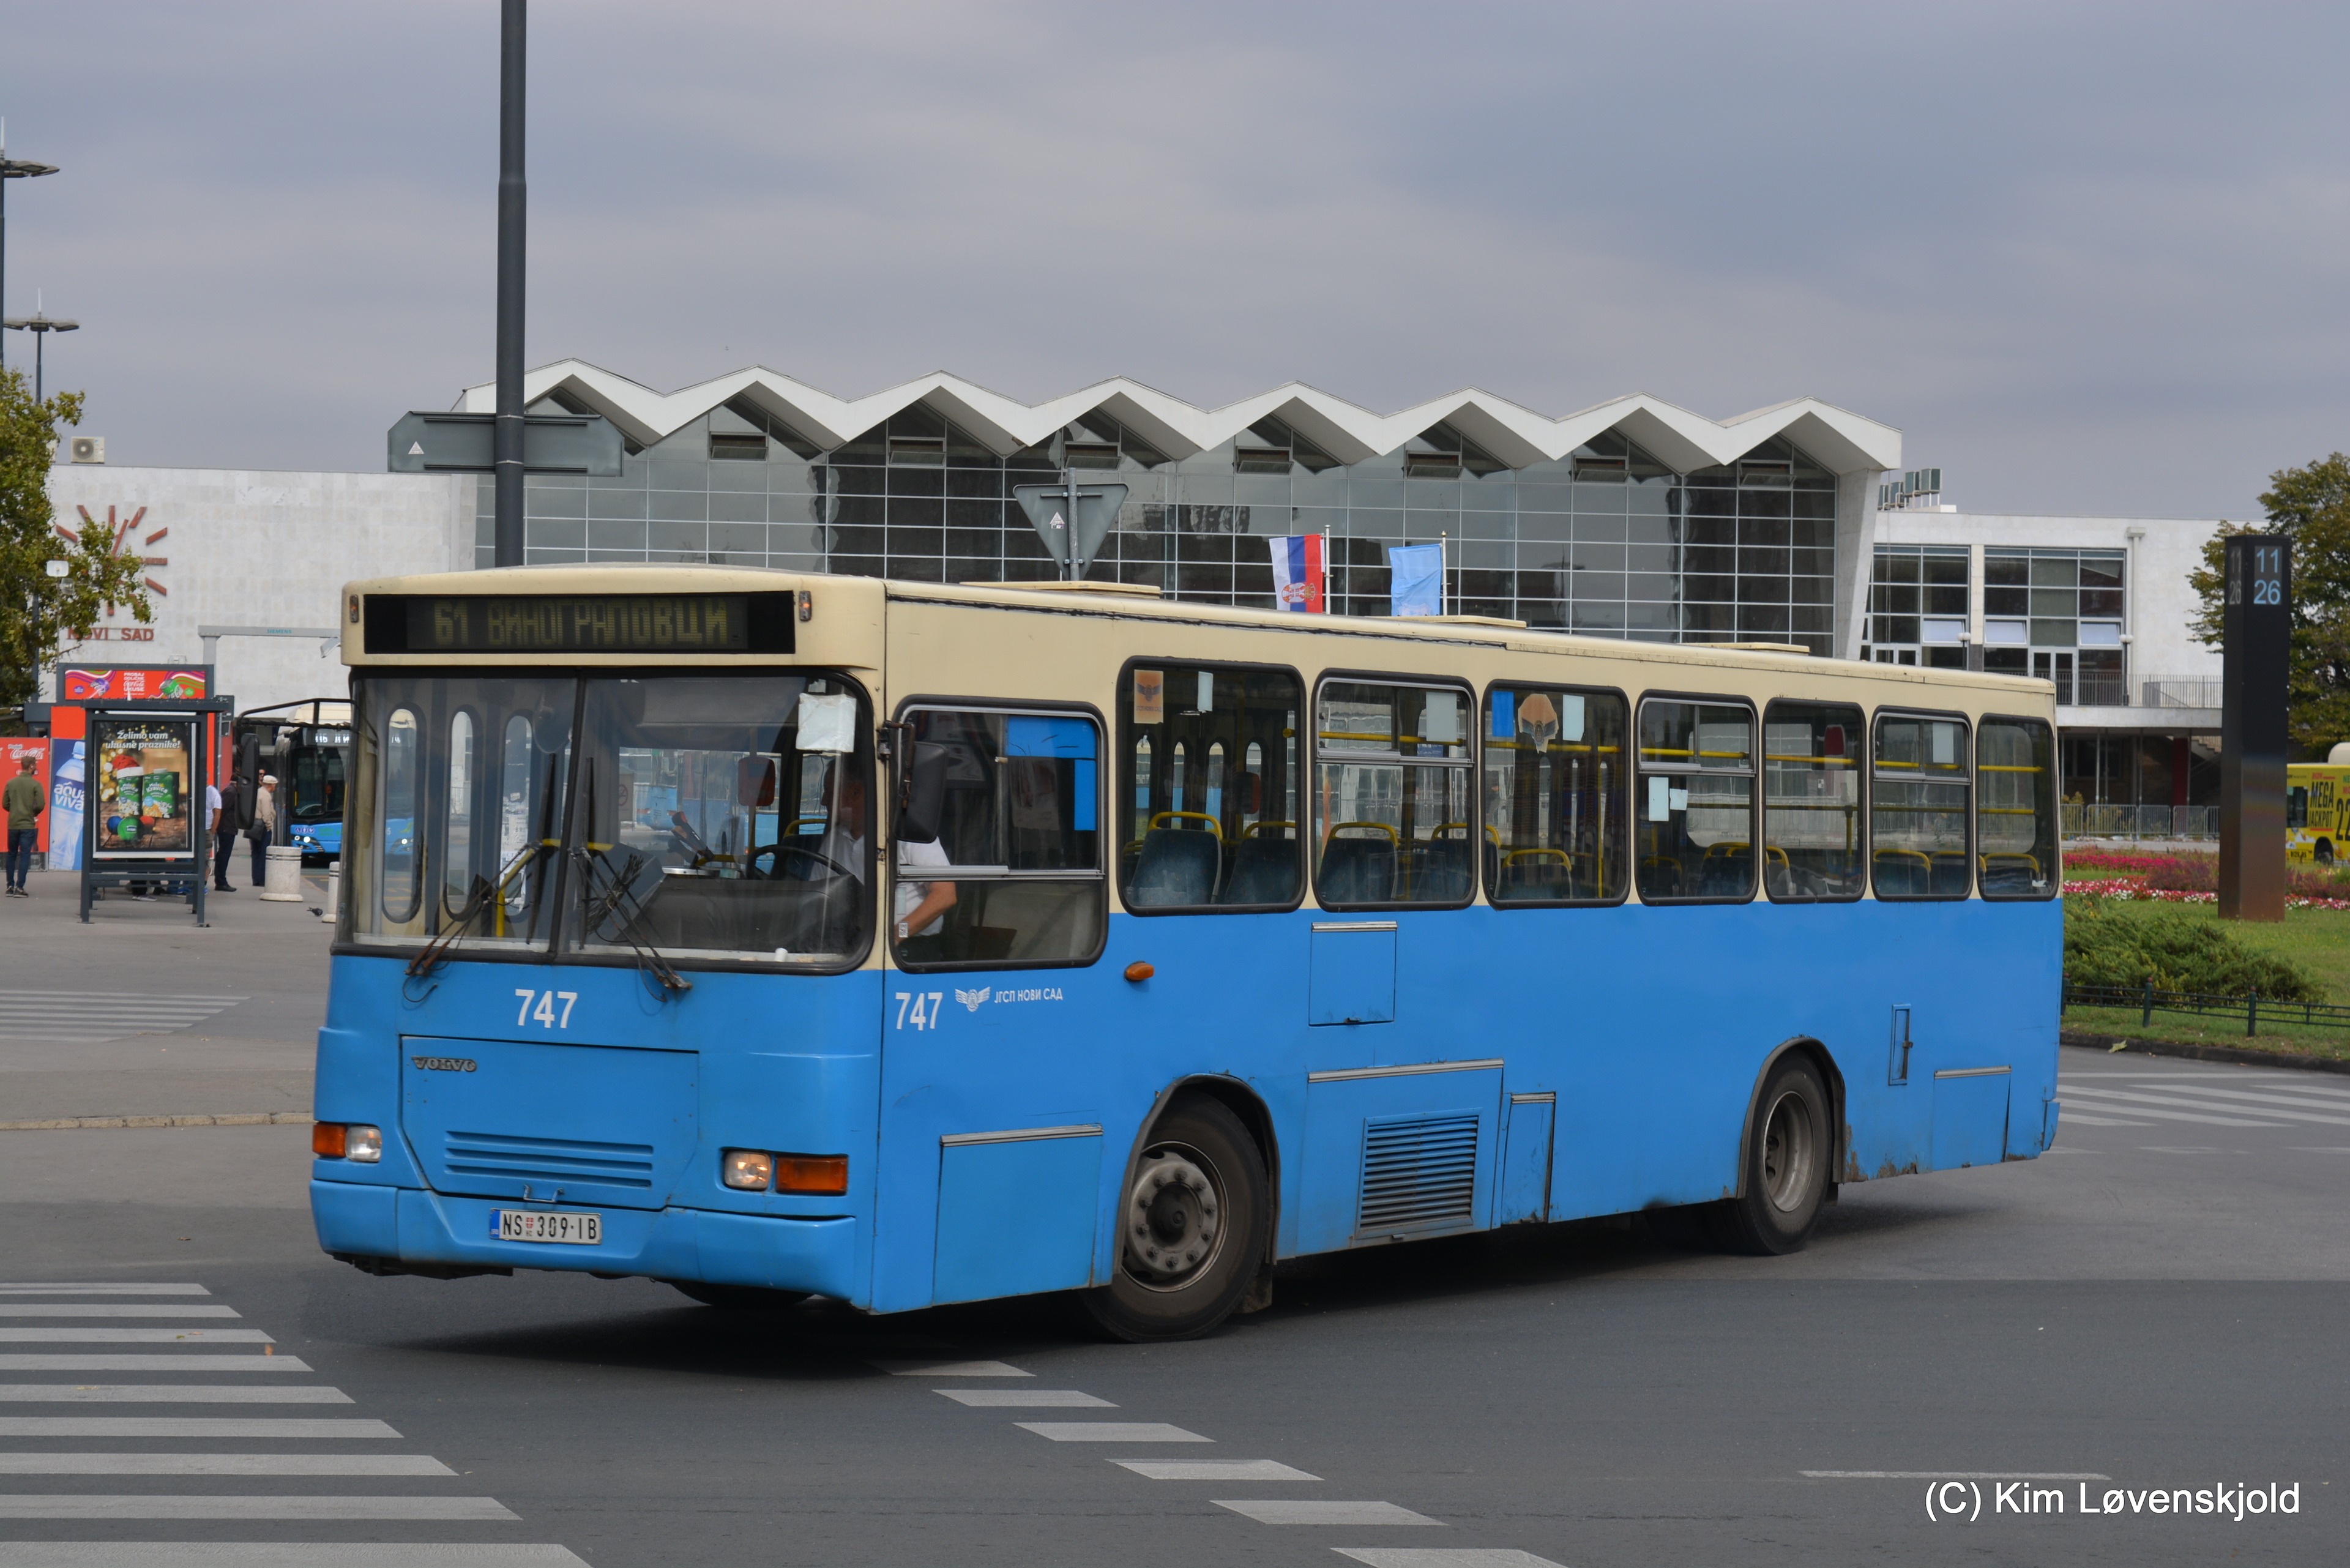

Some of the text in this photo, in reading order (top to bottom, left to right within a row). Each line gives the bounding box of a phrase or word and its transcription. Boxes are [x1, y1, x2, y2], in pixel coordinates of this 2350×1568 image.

[2256, 548, 2278, 573] 11
[2229, 580, 2241, 605] 26
[2253, 579, 2281, 605] 26
[435, 601, 469, 644] 61
[121, 627, 154, 641] SAD
[117, 730, 147, 739] Želimo
[138, 741, 181, 751] praznike!
[54, 794, 84, 811] viva
[2310, 782, 2333, 808] MEGA
[2308, 810, 2333, 827] JACKPOT
[1017, 989, 1041, 1002] НОВИ
[1043, 988, 1063, 1001] САД
[515, 988, 578, 1029] 747
[895, 992, 943, 1031] 747
[411, 1056, 477, 1072] VOLVO
[503, 1214, 522, 1236] NS
